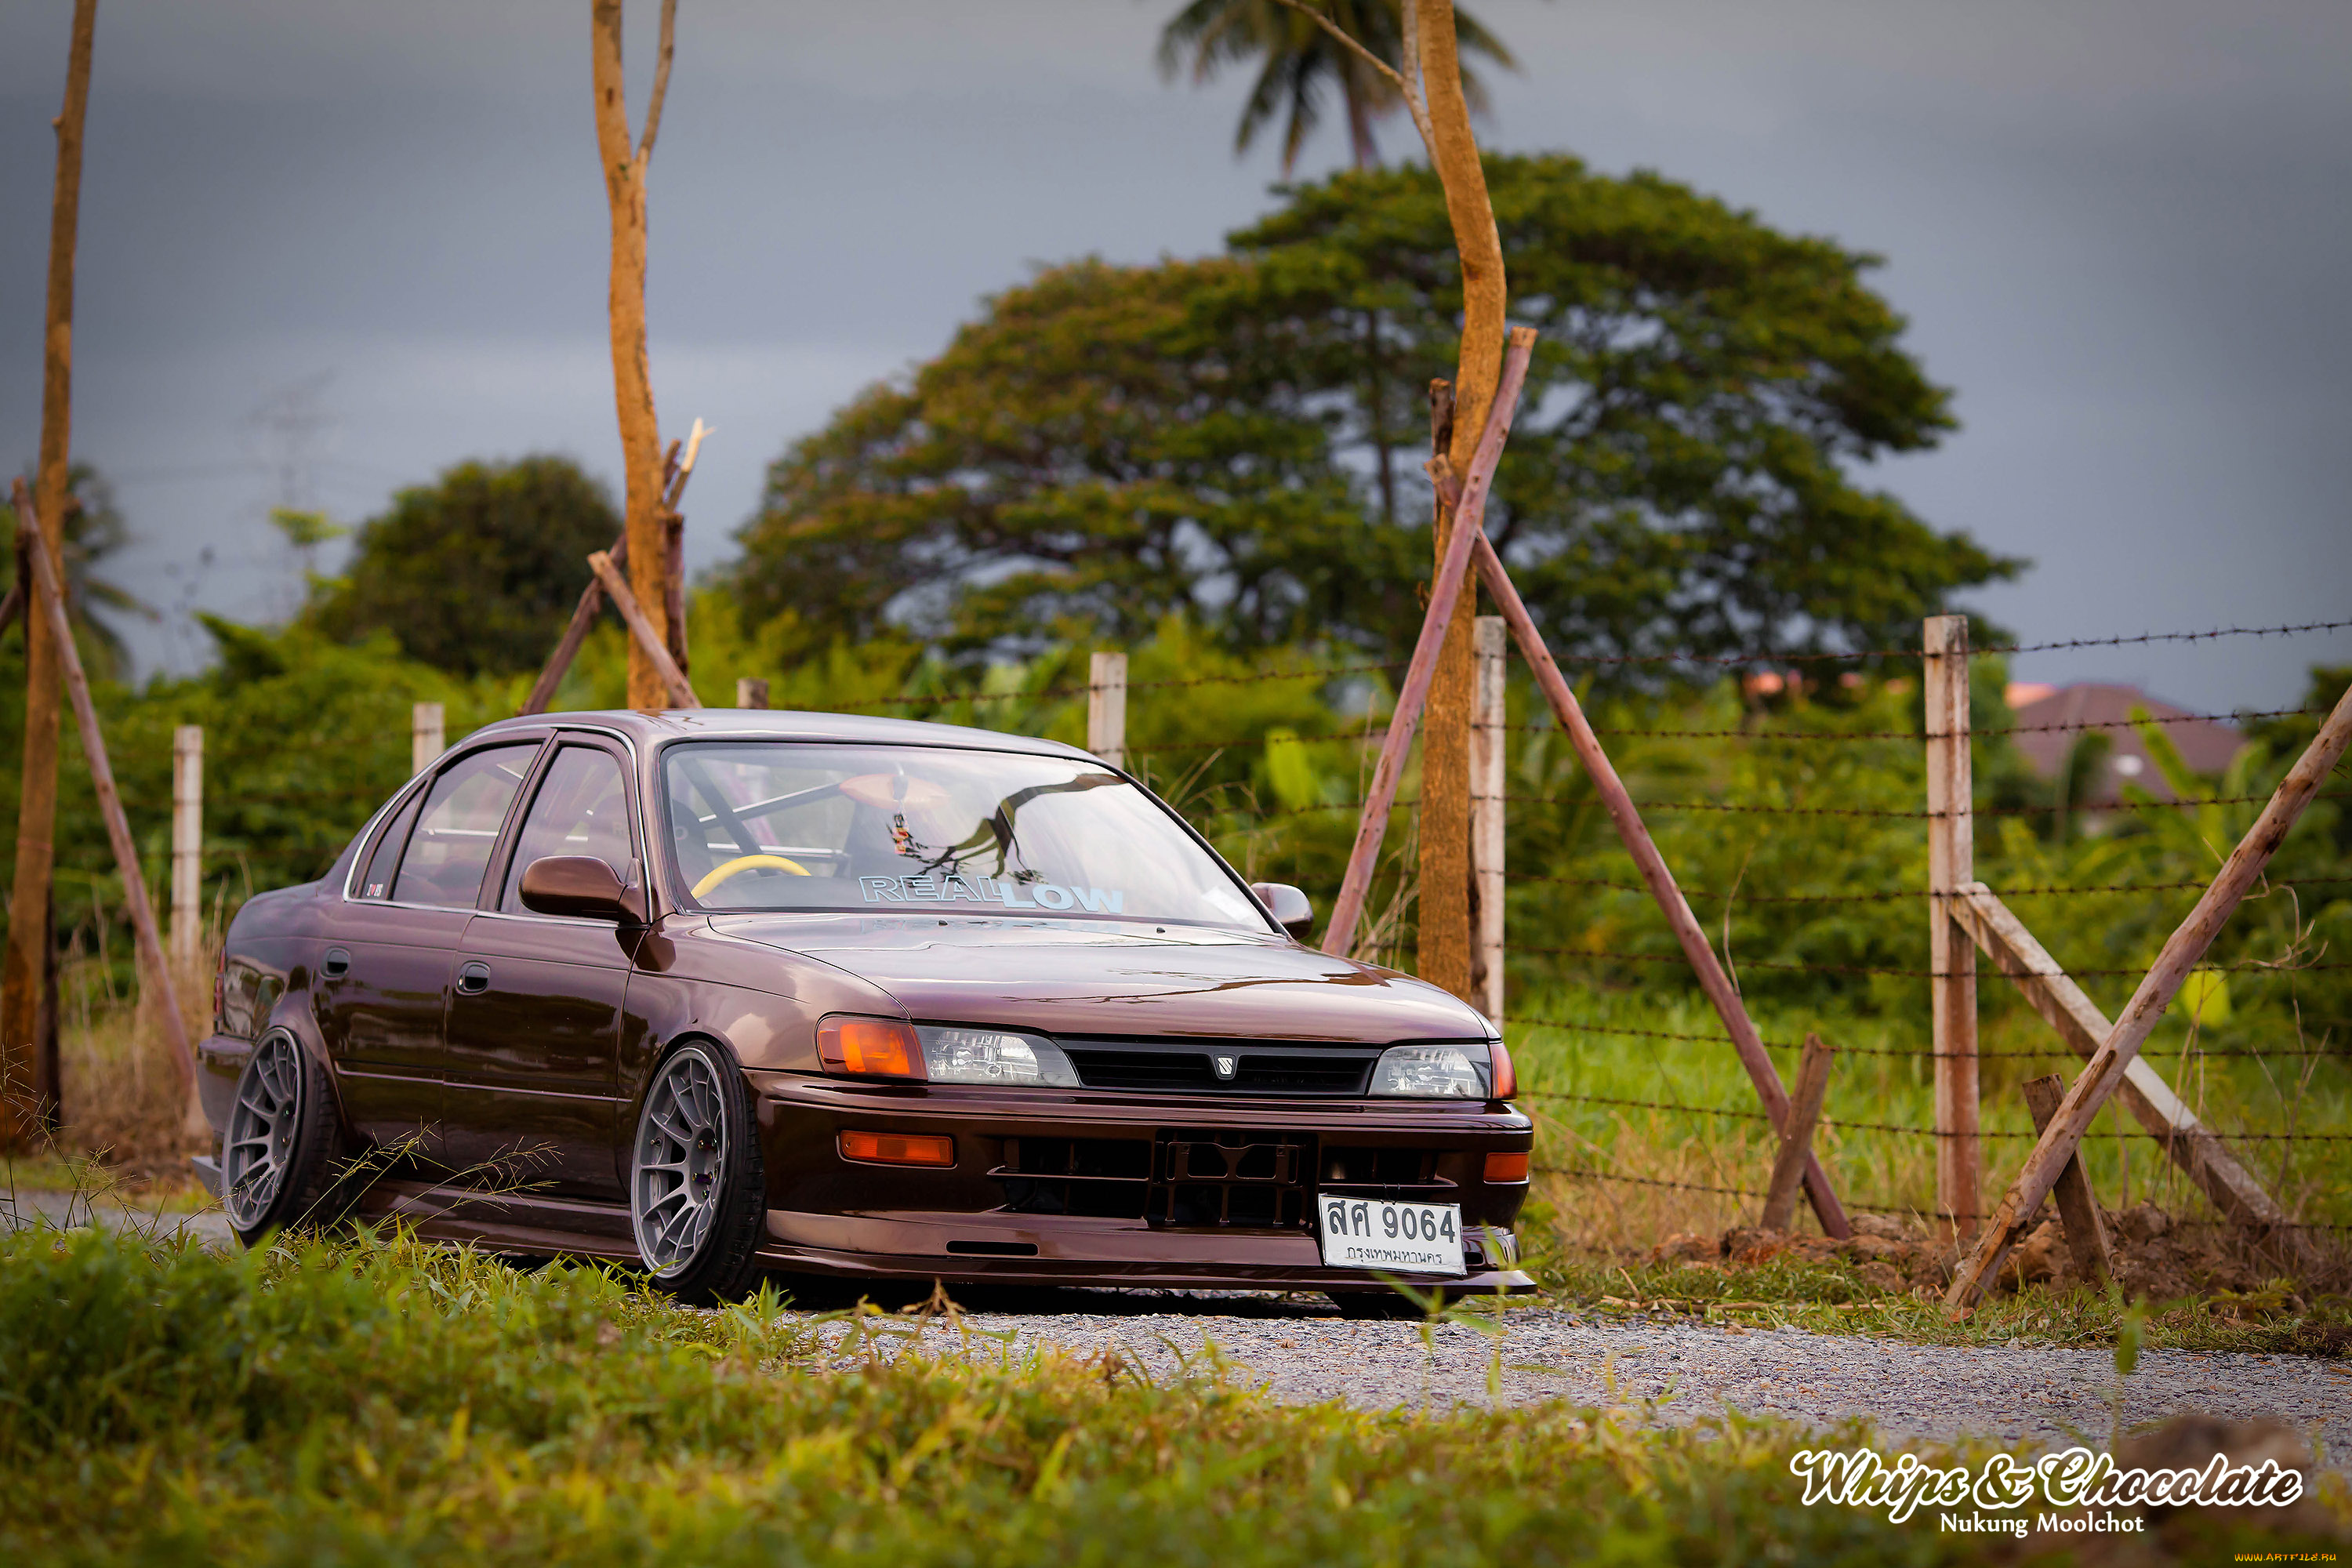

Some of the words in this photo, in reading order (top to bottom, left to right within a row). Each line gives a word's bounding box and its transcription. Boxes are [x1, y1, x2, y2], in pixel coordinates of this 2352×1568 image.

[1327, 1200, 1370, 1236] สศ
[1382, 1206, 1456, 1243] 9064
[1347, 1247, 1443, 1265] กรุงเทพมหานคร
